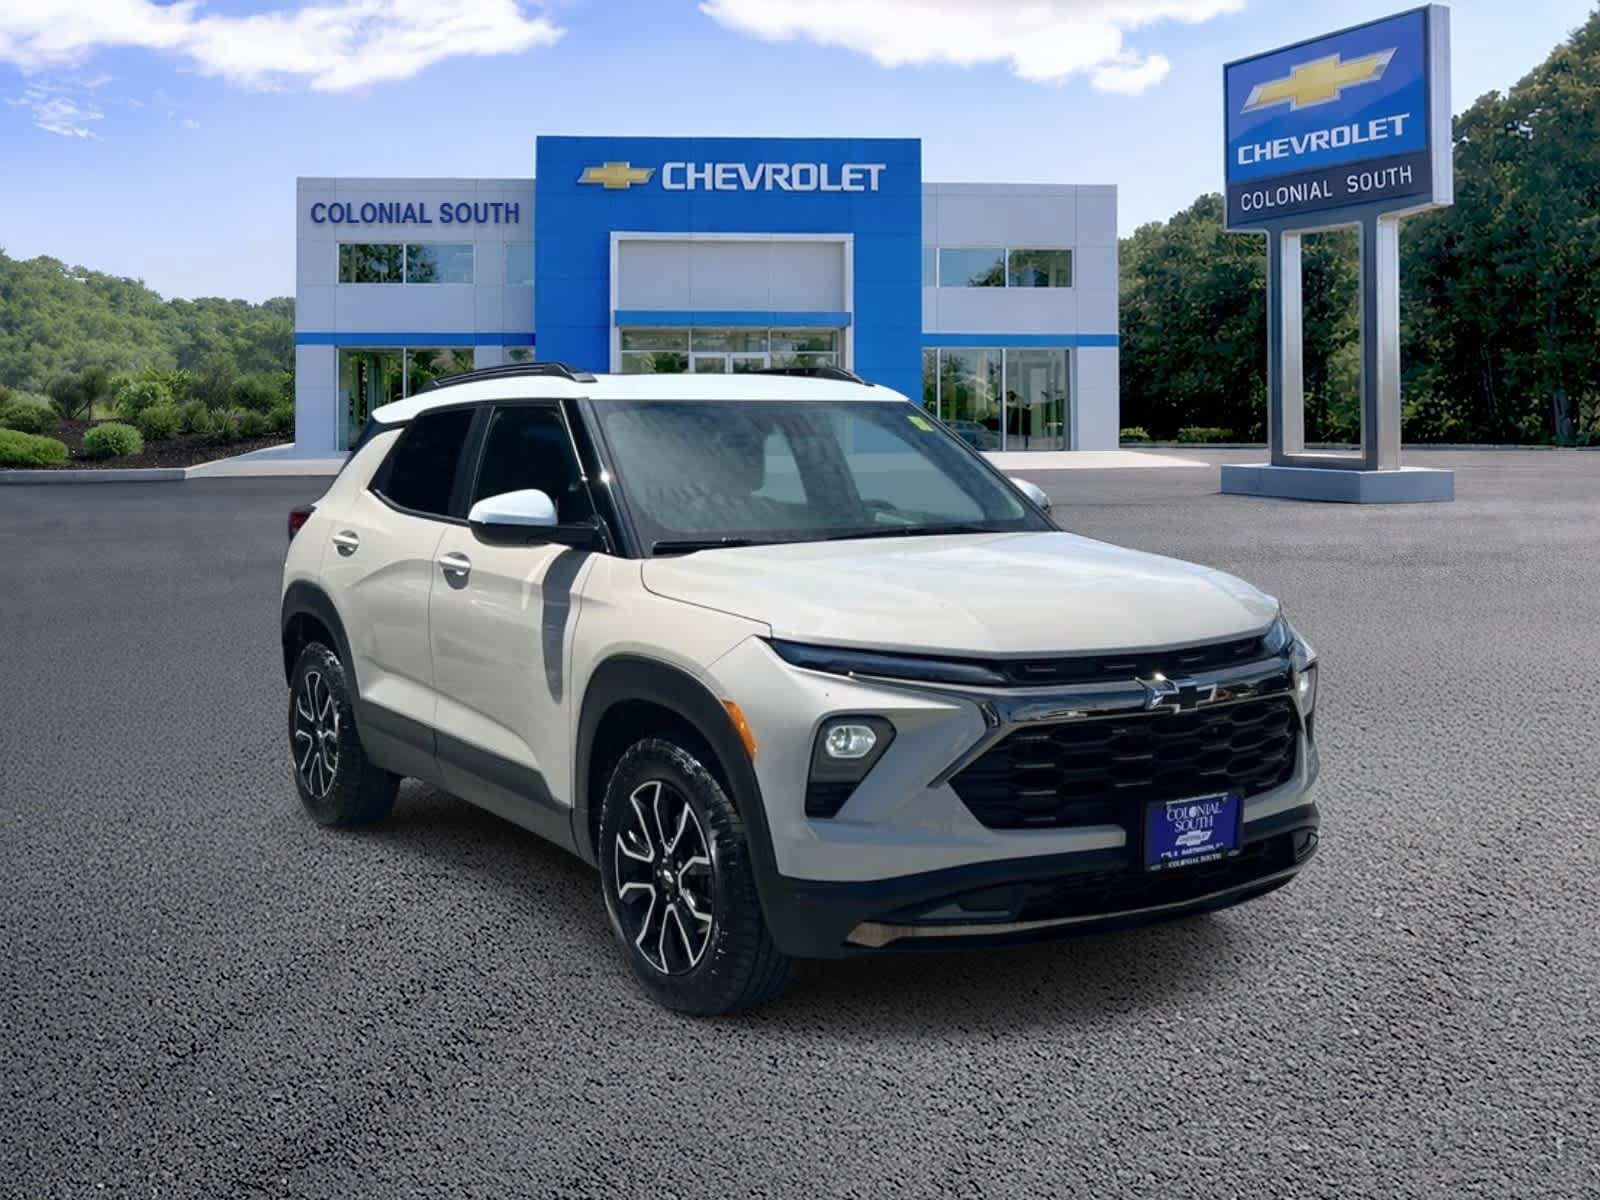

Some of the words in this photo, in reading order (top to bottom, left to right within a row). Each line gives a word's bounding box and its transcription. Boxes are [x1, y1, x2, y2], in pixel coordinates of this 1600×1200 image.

[1237, 113, 1410, 165] CHEVROLET
[661, 161, 887, 192] CHEVROLET
[1240, 180, 1333, 211] COLONIAL
[1346, 165, 1412, 193] SOUTH
[310, 202, 432, 224] COLONIAL
[439, 202, 520, 224] SOUTH
[1166, 802, 1223, 821] COLONIAL
[1174, 815, 1214, 833] SOUTH
